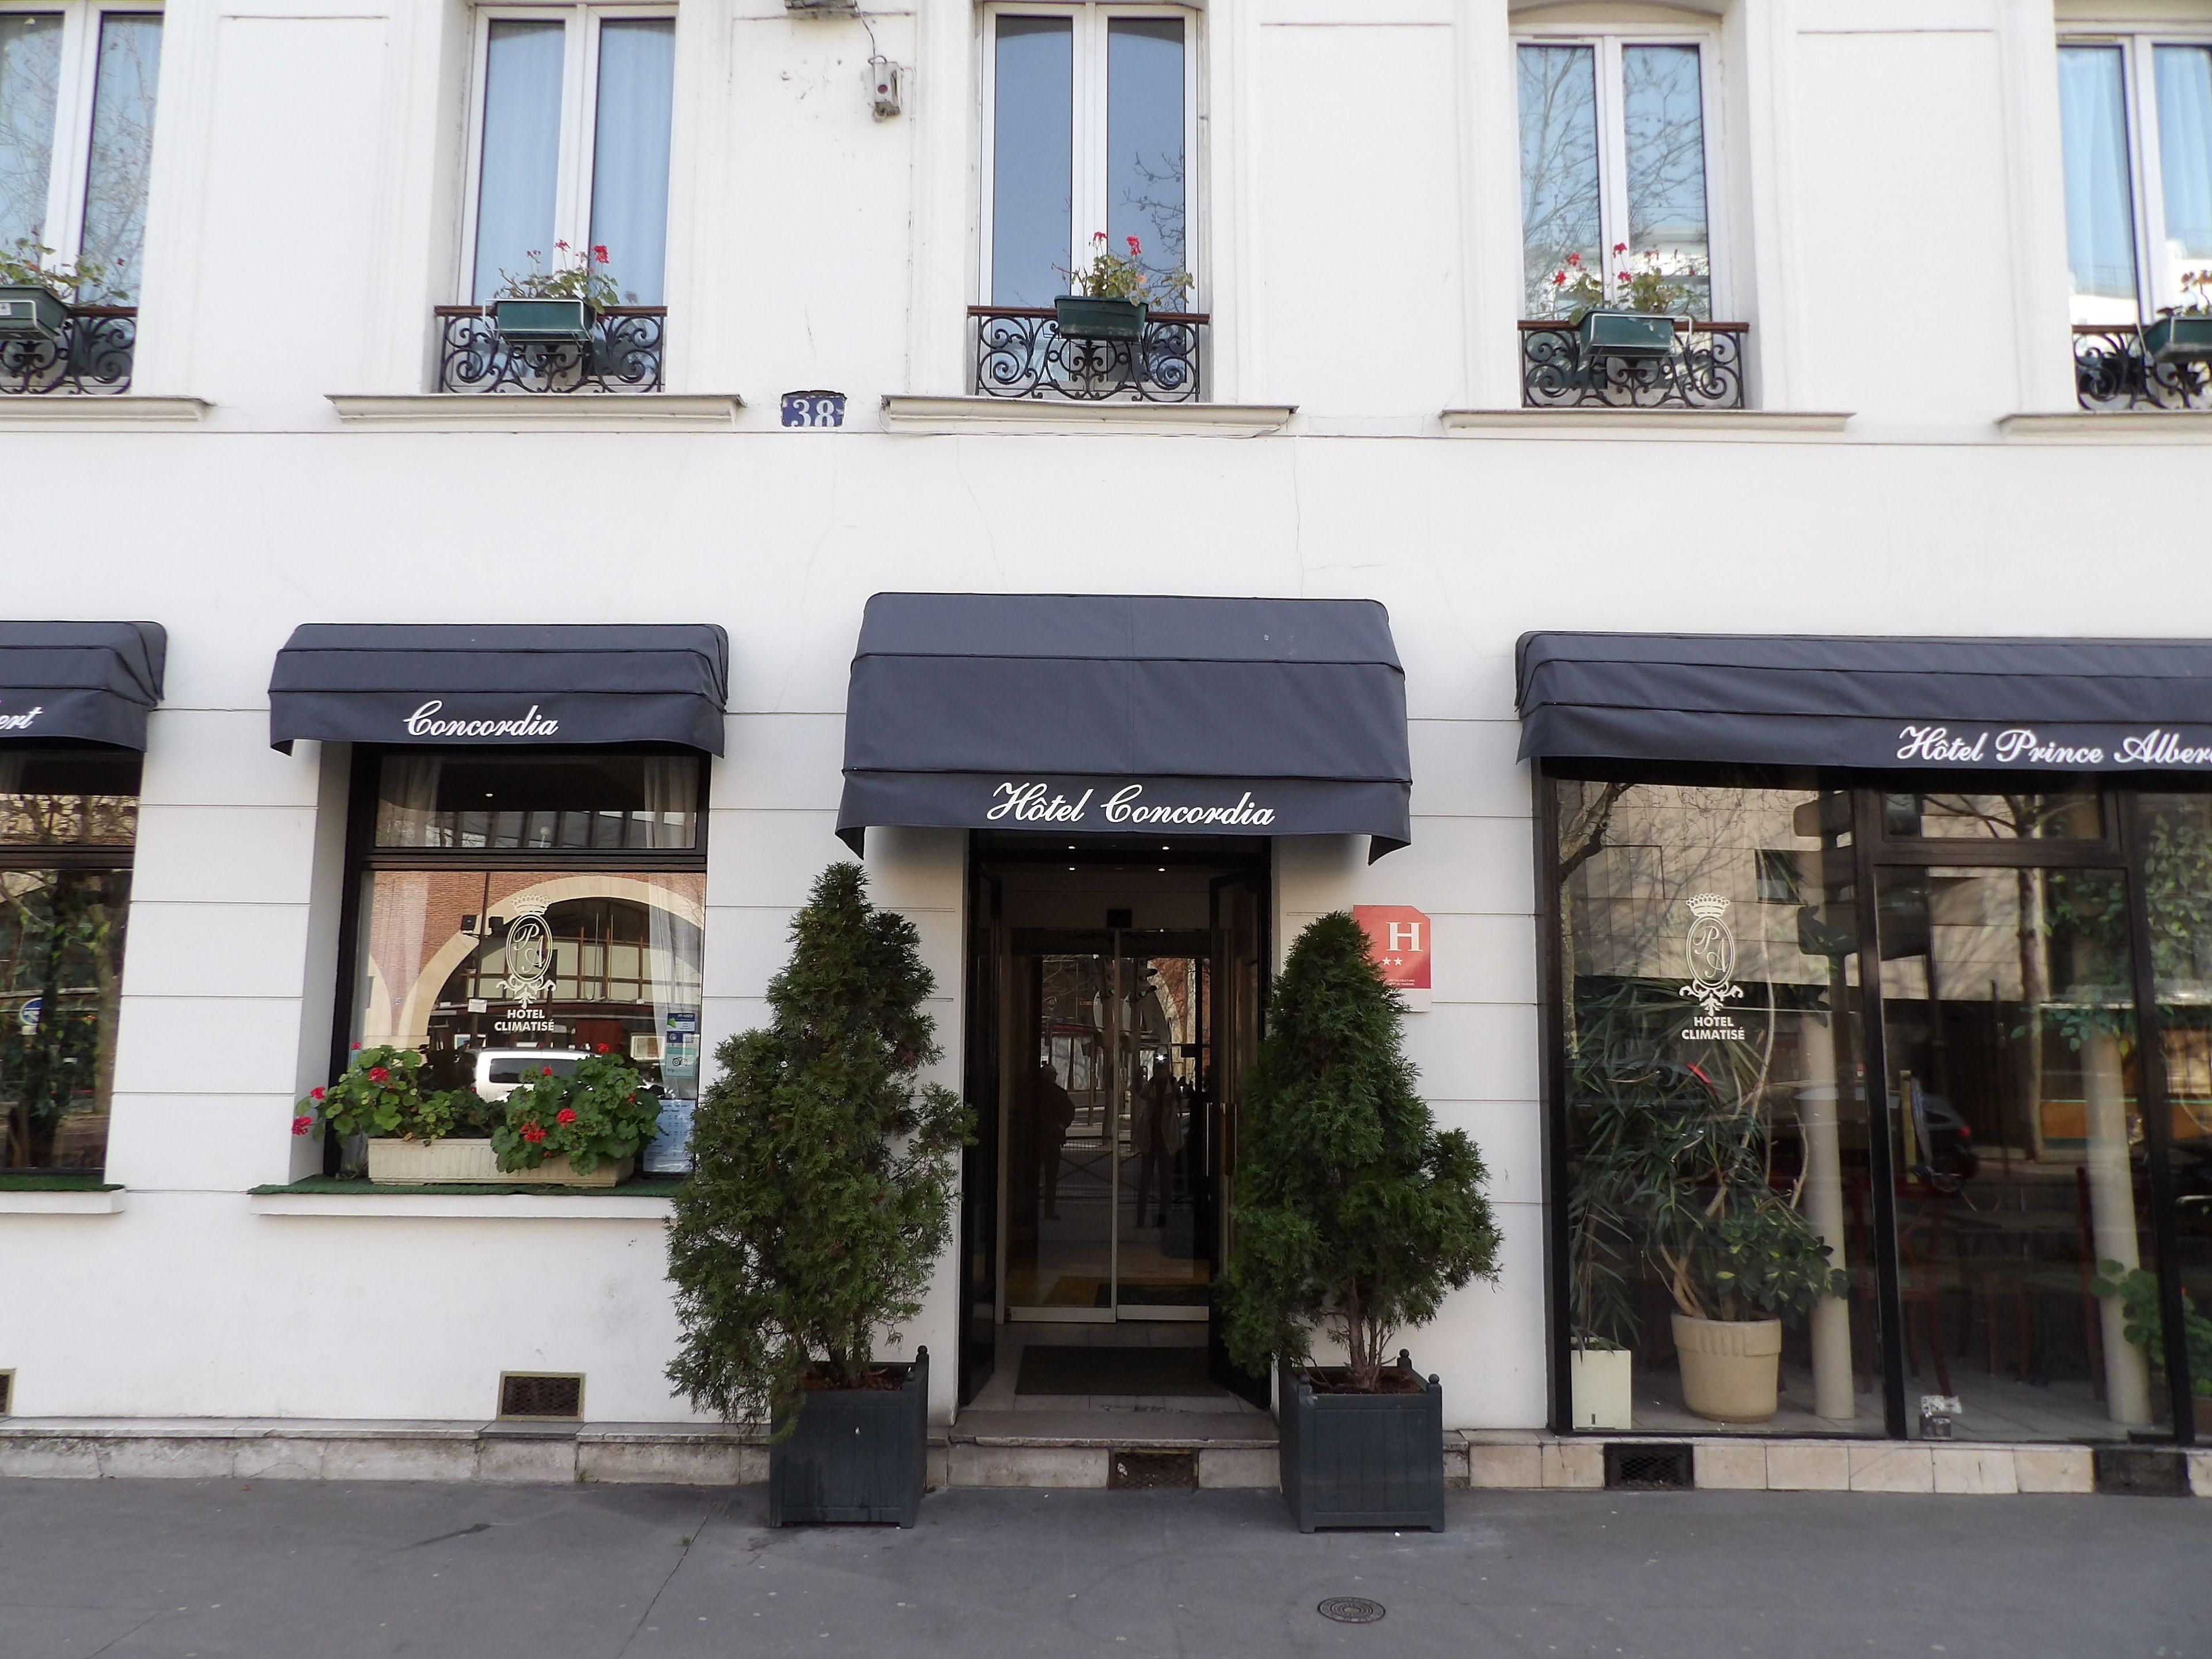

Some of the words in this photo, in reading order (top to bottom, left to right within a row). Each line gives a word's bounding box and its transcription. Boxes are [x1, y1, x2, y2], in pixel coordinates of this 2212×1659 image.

[790, 399, 835, 427] 38
[0, 706, 44, 730] ert
[403, 700, 559, 736] Concordia
[1896, 726, 1988, 762] Hôtel
[1995, 729, 2104, 764] Prince
[2113, 729, 2212, 764] Alber
[986, 782, 1094, 822] Hôtel
[1100, 784, 1275, 826] Concordia
[1386, 922, 1423, 952] H
[494, 1019, 555, 1032] CLIMATISÉ
[507, 1009, 546, 1019] HOTEL
[1694, 1017, 1734, 1027] HOTEL
[1681, 1027, 1745, 1040] CLIMATISÉ
